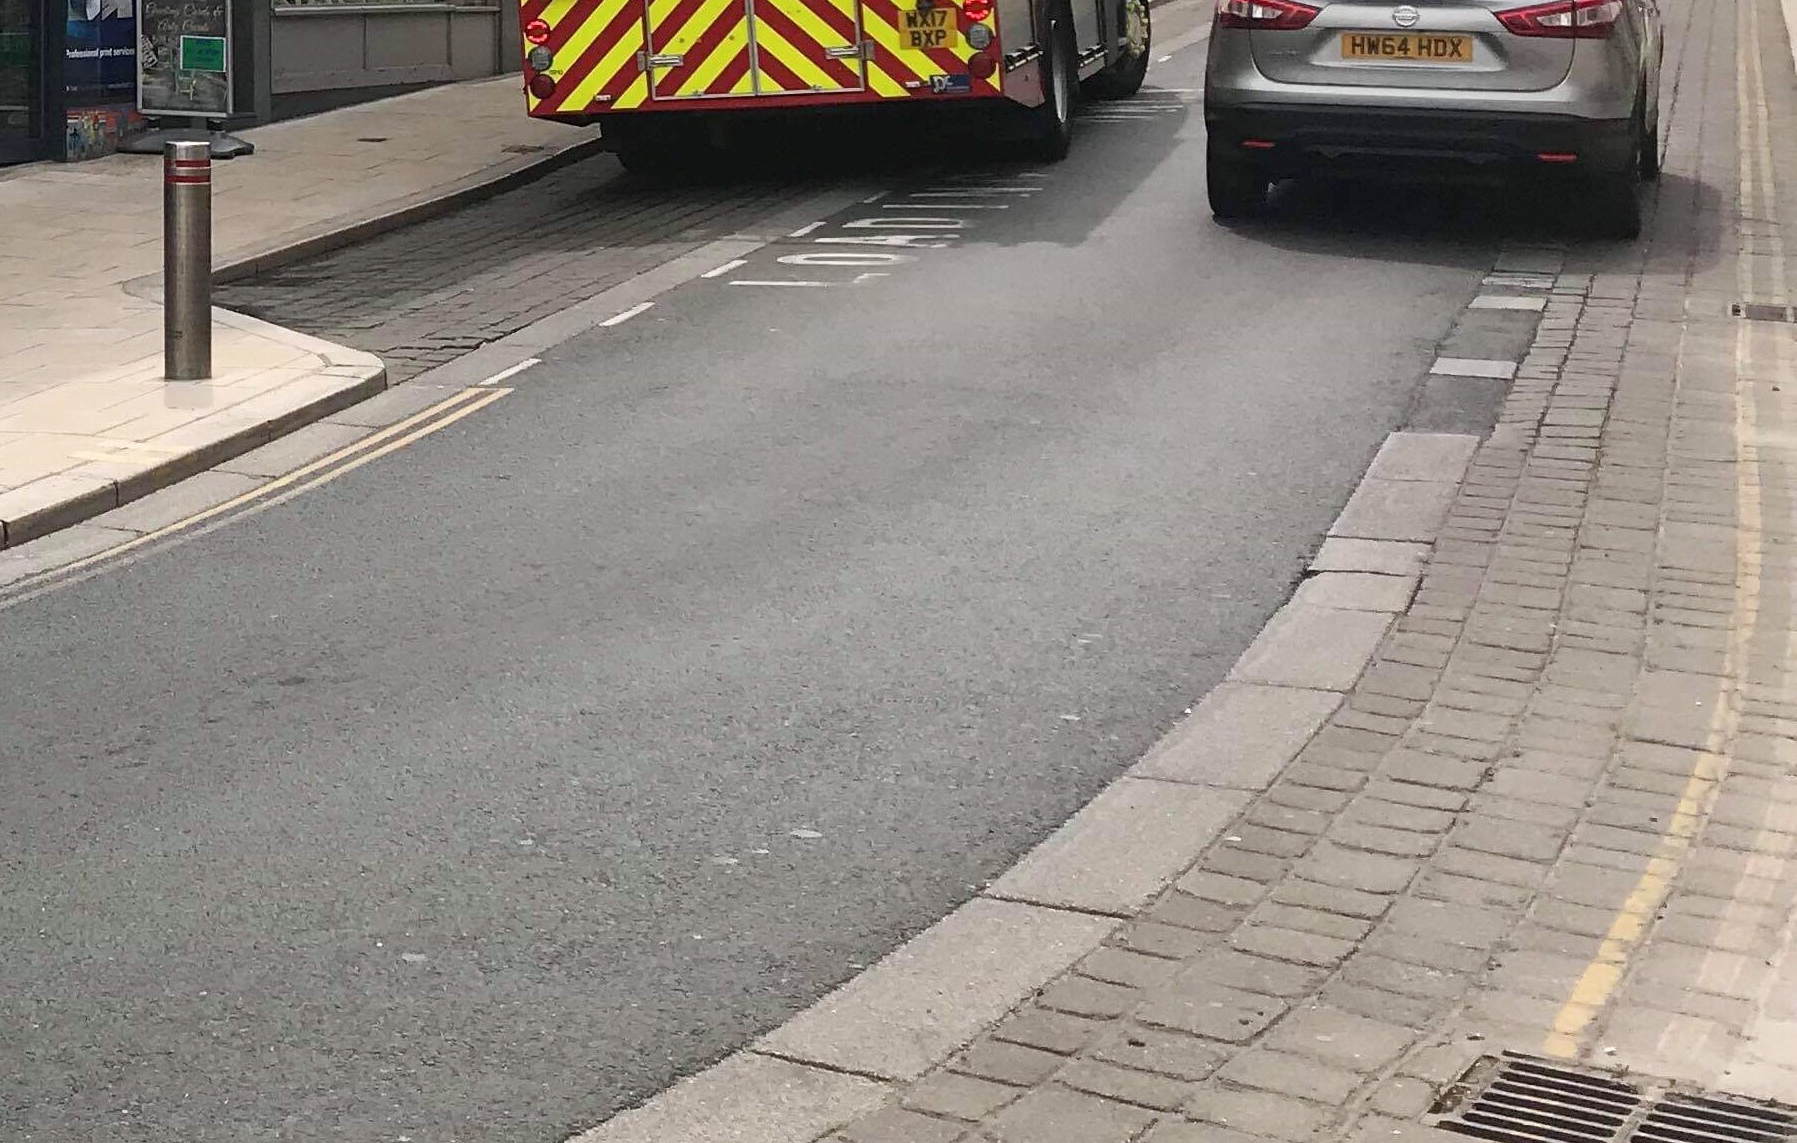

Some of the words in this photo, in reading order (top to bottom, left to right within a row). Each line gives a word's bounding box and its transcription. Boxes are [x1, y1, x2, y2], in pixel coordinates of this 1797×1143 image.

[910, 29, 947, 46] BXP
[1351, 36, 1411, 56] HW64
[1418, 36, 1463, 58] HDX
